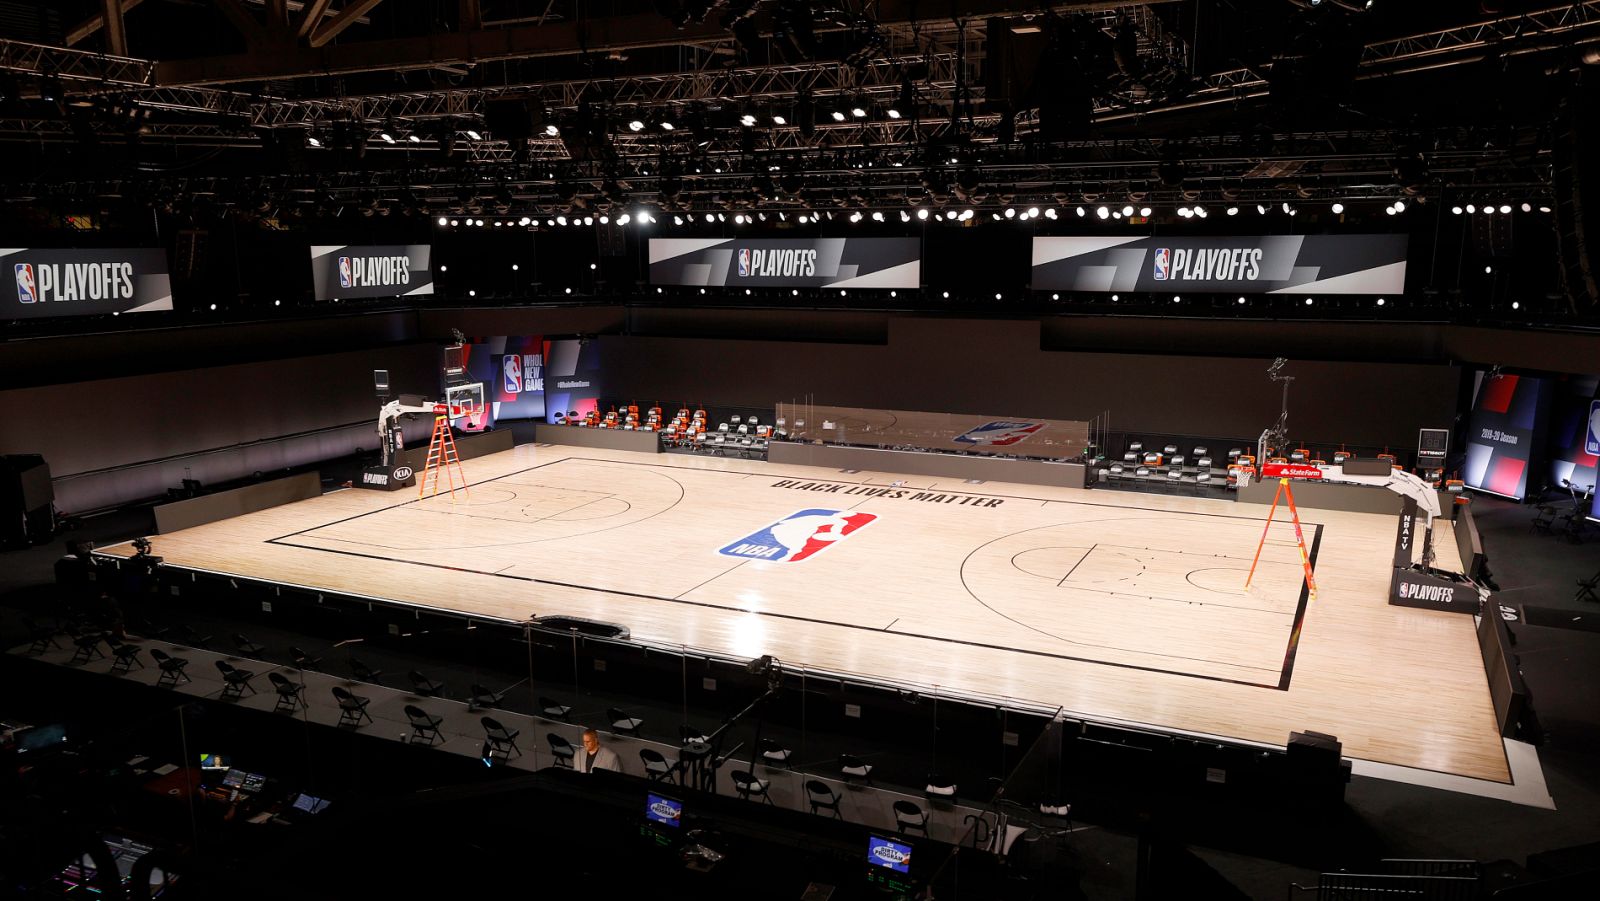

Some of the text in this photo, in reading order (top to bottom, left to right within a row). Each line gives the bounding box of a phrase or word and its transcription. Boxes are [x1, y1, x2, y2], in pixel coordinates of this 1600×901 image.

[750, 249, 817, 276] PLAYOFFS
[1170, 248, 1263, 280] PLAYOFFS
[352, 256, 409, 287] PLAYOFFS
[37, 262, 134, 302] PLAYOFFS
[524, 354, 543, 367] WHOL
[524, 366, 540, 379] NEW
[525, 378, 544, 392] GAME
[1588, 442, 1599, 452] NBA
[396, 469, 410, 478] KIA
[770, 480, 1005, 508] BLACK LIVES MATTER
[1401, 515, 1411, 550] NBA TV
[728, 544, 782, 558] NBA
[1408, 583, 1454, 603] PLAYOFFS
[875, 849, 903, 861] PROGRAM
[880, 847, 898, 855] DIRTY
